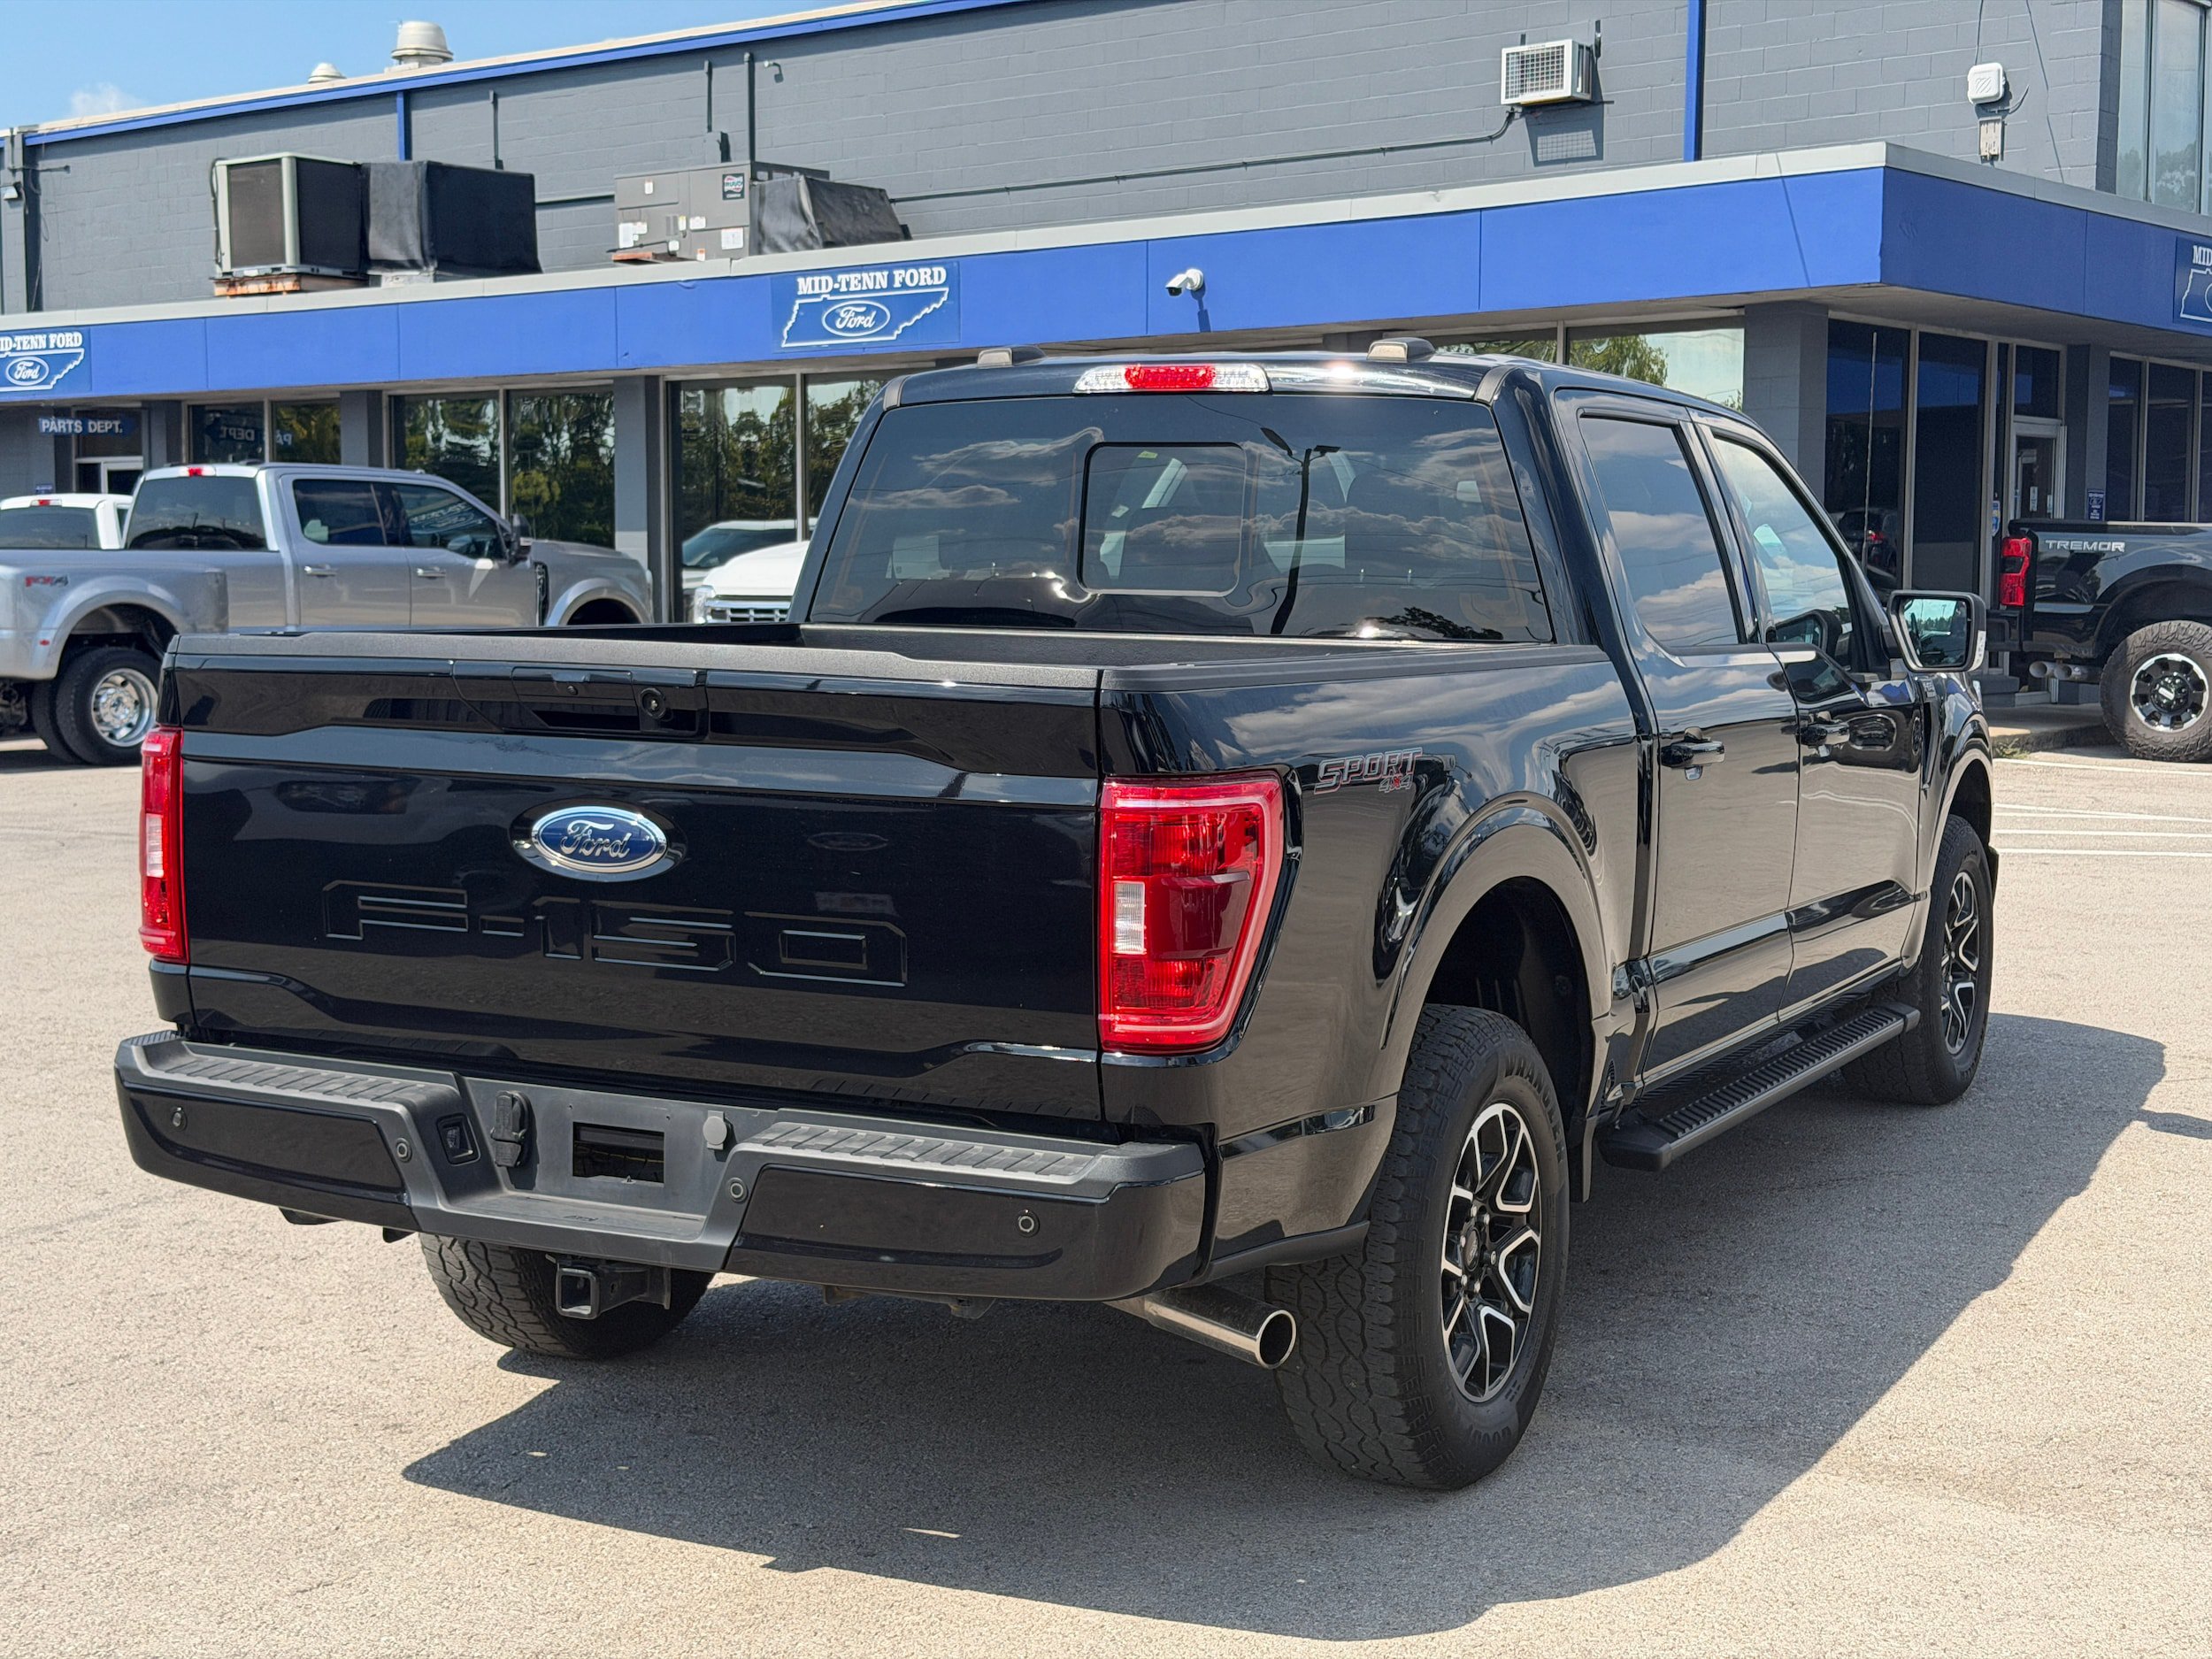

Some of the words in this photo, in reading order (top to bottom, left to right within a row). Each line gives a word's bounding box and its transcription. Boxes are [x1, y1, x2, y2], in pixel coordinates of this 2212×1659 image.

[797, 271, 889, 296] MID-TENN
[893, 266, 947, 288] FORD
[835, 306, 876, 329] Ford
[0, 334, 47, 352] ID-TENN
[49, 331, 83, 349] FORD
[14, 361, 41, 380] Ford
[42, 418, 83, 434] PARTS
[88, 419, 123, 434] DEPT.
[2045, 539, 2125, 553] TREMOR
[1314, 747, 1423, 795] SPORT
[562, 818, 632, 861] Ford
[322, 879, 908, 987] F-150
[1504, 1052, 1566, 1165] WRANGLER
